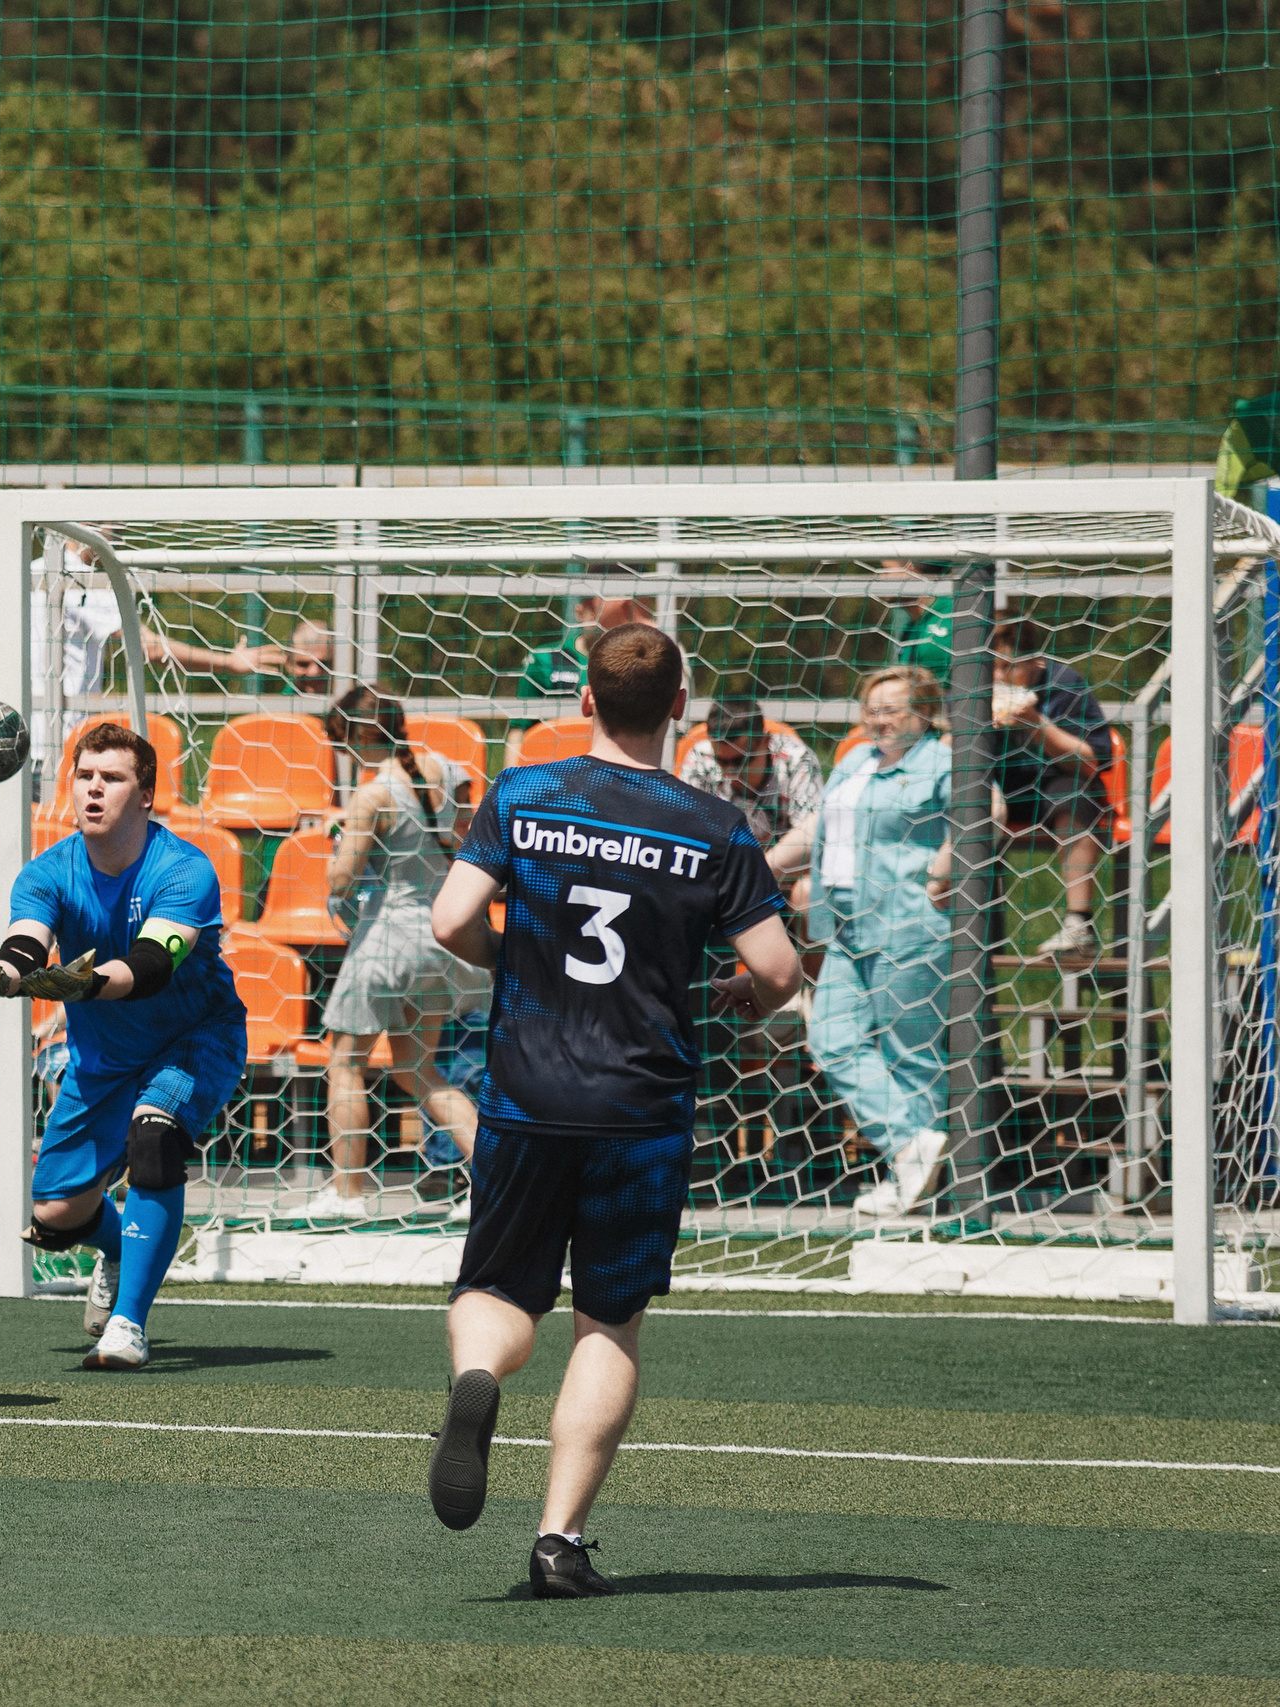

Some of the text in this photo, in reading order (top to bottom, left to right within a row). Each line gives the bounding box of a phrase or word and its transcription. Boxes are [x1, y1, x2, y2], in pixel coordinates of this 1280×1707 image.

[512, 819, 709, 879] Umbrella IT
[564, 884, 632, 985] 3
